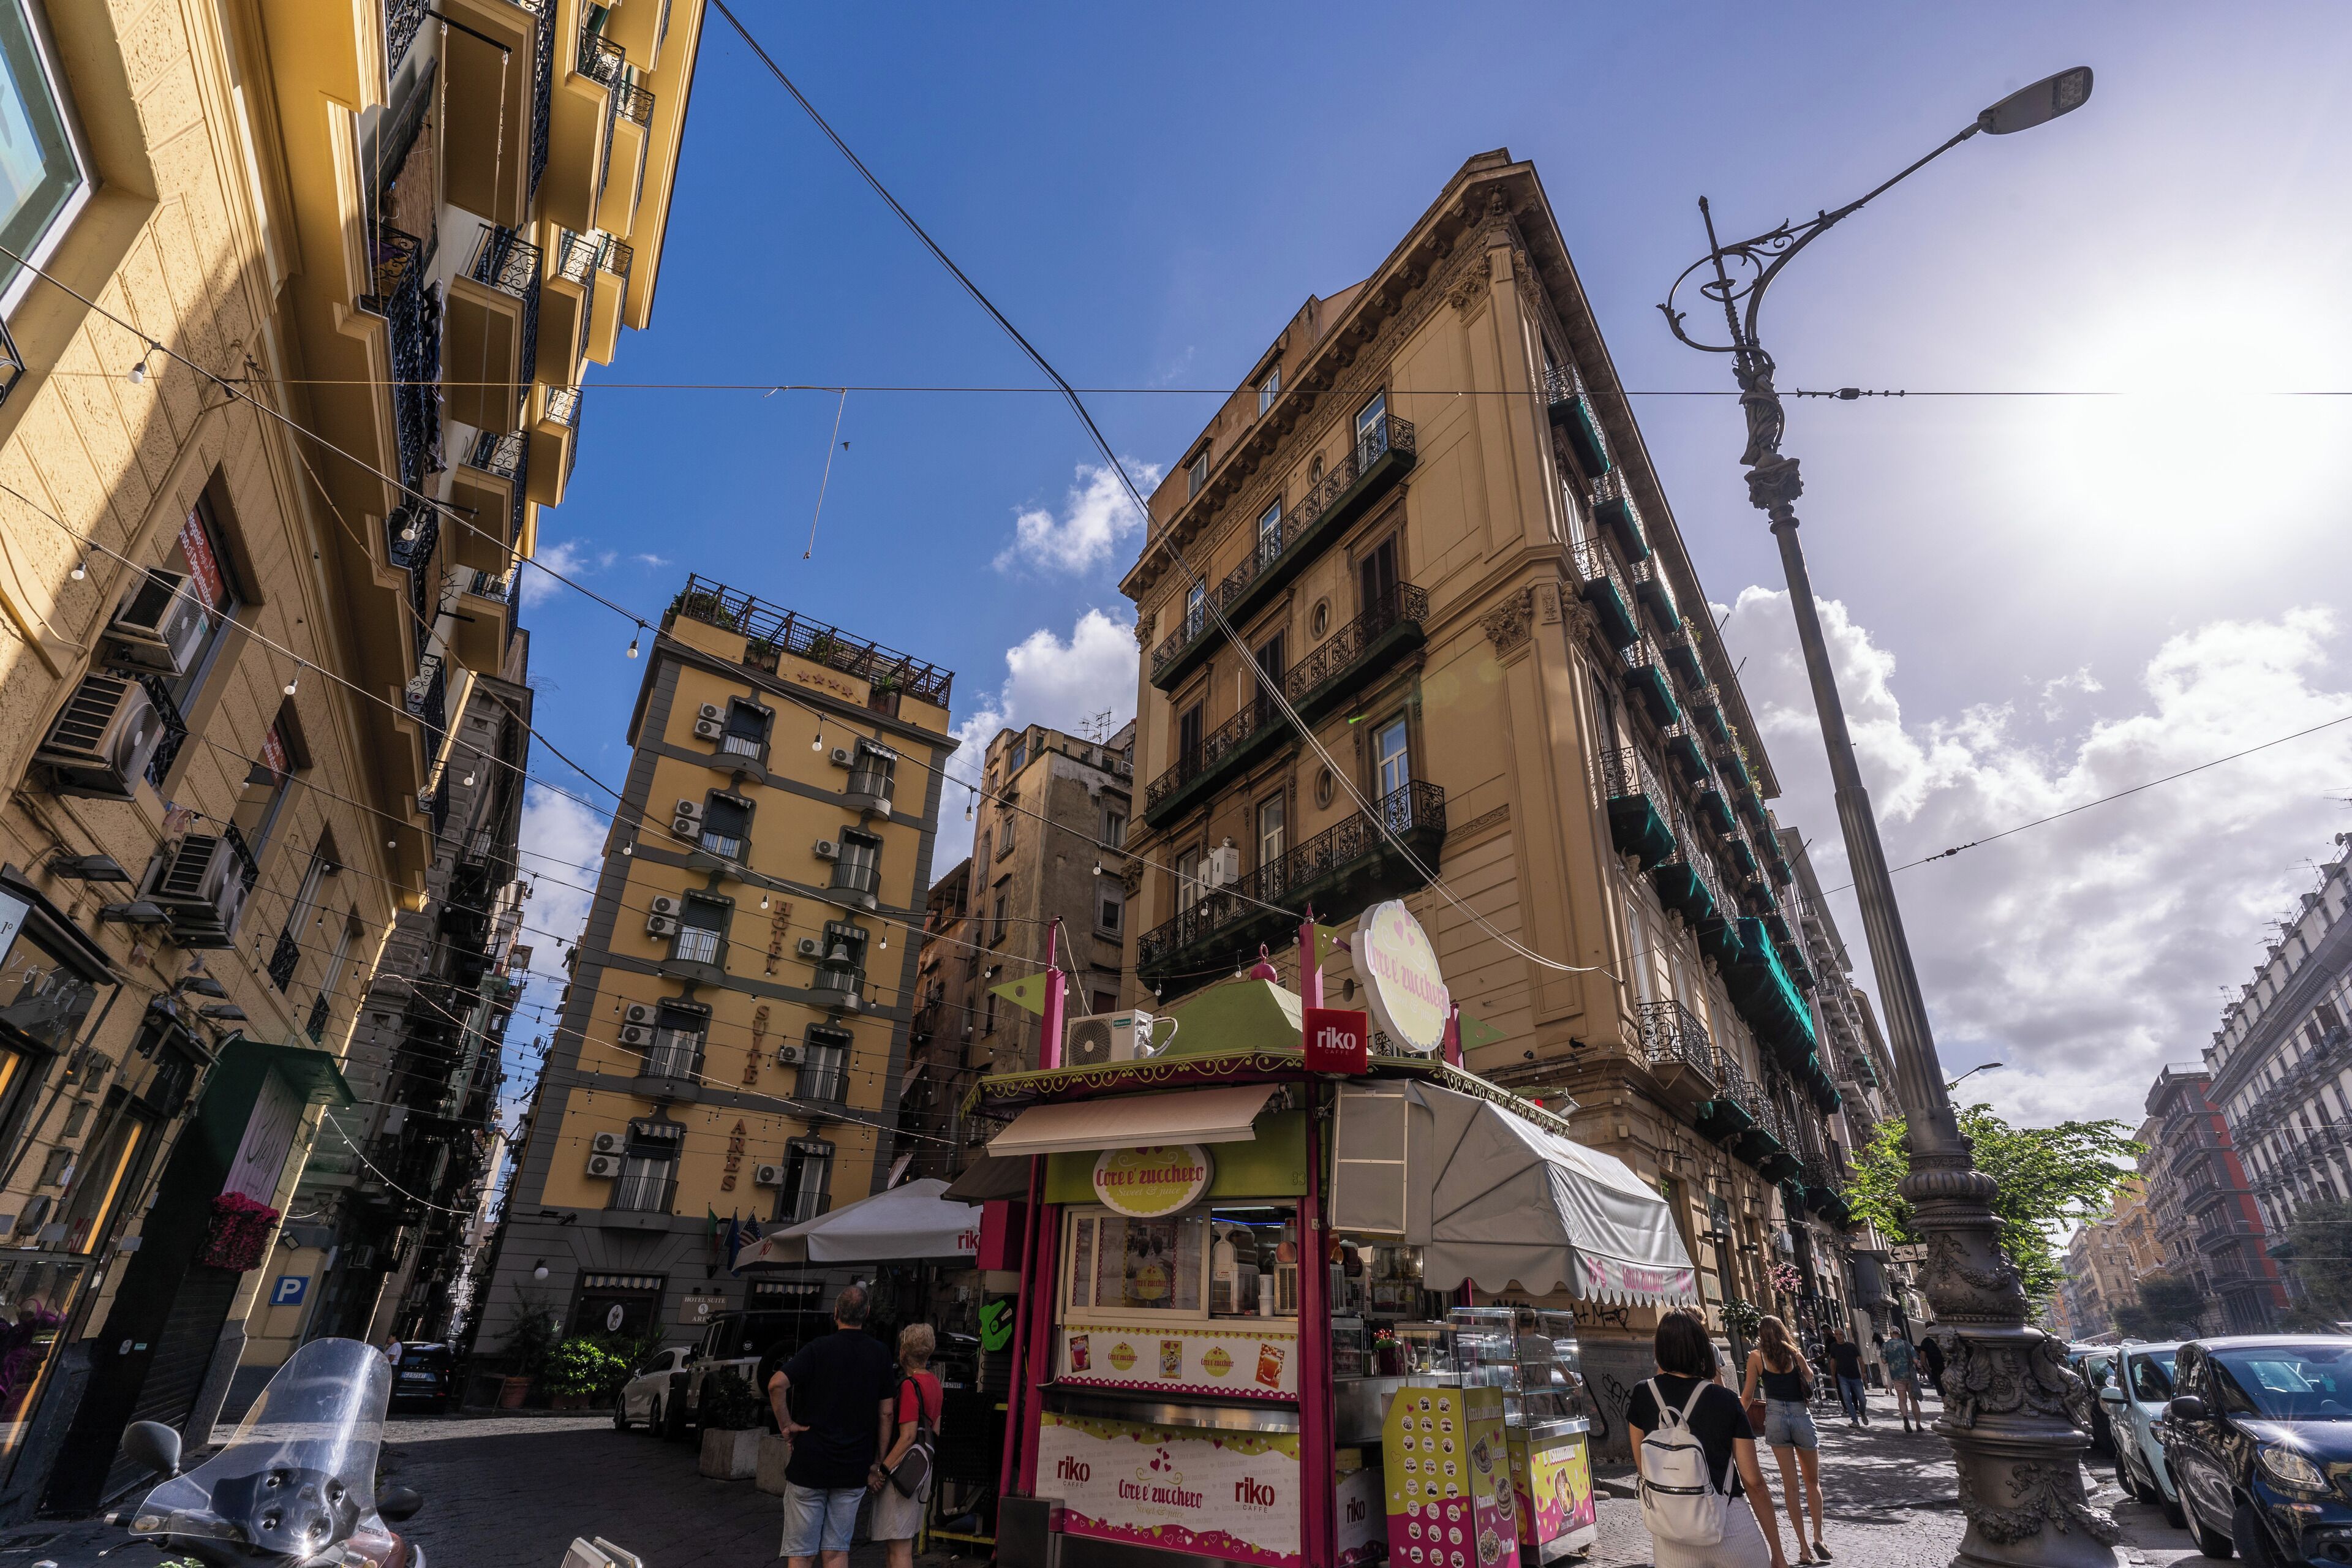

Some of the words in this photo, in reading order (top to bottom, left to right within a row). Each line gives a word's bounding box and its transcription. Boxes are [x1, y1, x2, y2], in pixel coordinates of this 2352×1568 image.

[187, 511, 204, 548] Regalo?
[765, 900, 793, 976] HOTEL
[1401, 965, 1449, 1014] zucchero
[742, 1005, 770, 1085] SUITE
[1317, 1027, 1357, 1050] riko
[720, 1118, 747, 1192] ARES
[1096, 1168, 1124, 1187] Core
[1139, 1164, 1204, 1185] zucchero
[1117, 1187, 1143, 1197] Sweet
[1145, 1186, 1158, 1195] &
[1158, 1186, 1181, 1197] juice
[957, 1230, 979, 1250] rik
[277, 1279, 301, 1302] P
[1057, 1455, 1090, 1482] riko
[1118, 1479, 1141, 1501] Core
[1152, 1485, 1203, 1509] zucchero
[1235, 1477, 1275, 1507] riko
[1135, 1504, 1156, 1515] Sweet
[1157, 1507, 1166, 1516] &
[1166, 1507, 1185, 1520] juice
[1243, 1504, 1268, 1513] CAFFÈ
[1347, 1497, 1365, 1524] riko
[1501, 1538, 1515, 1555] Waffle
